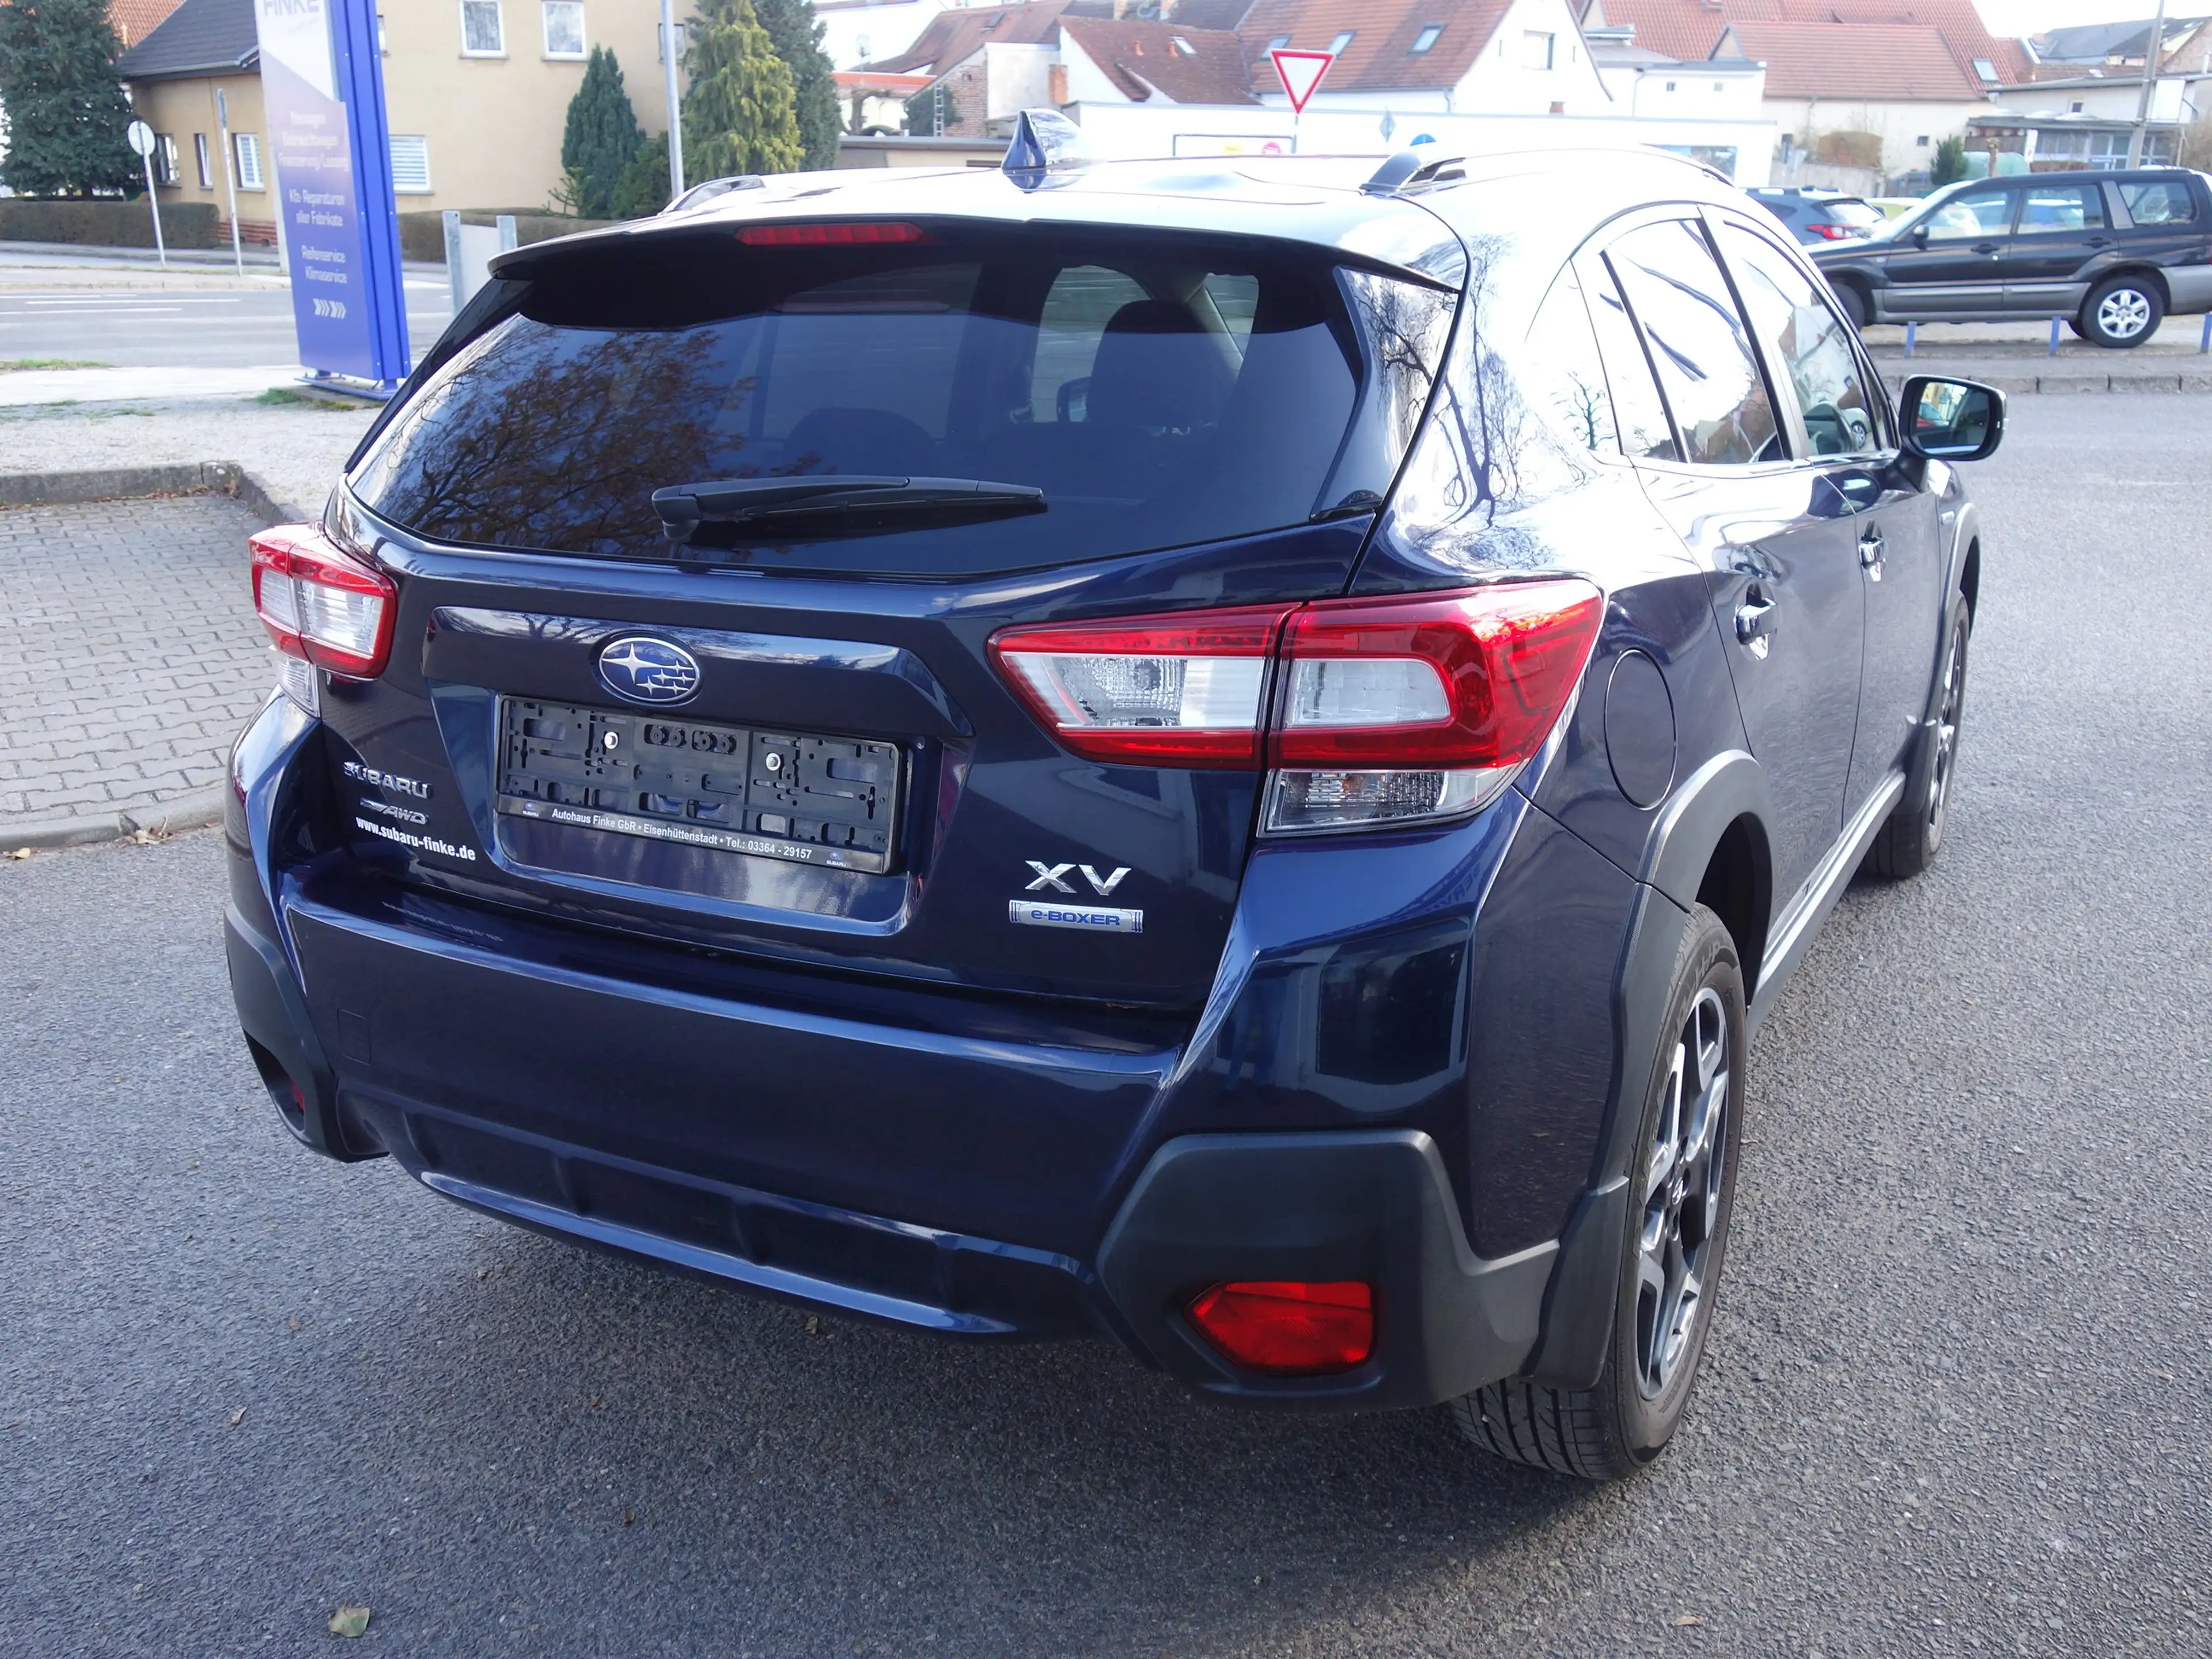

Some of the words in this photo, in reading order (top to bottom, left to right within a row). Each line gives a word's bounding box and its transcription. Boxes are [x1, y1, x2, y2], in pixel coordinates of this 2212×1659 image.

[343, 762, 430, 799] SUBARU
[382, 805, 429, 825] AWD
[355, 817, 476, 861] www.subaru-finke.de
[552, 808, 591, 824] Autohaus
[593, 815, 615, 827] Finke
[618, 819, 636, 831] GbR
[643, 824, 718, 845] Eisenhüttenstadt
[726, 837, 745, 849] Tel.:
[748, 840, 775, 854] 03364
[783, 846, 812, 859] 29157
[1025, 860, 1132, 896] XV
[1031, 910, 1121, 926] e-BOXER
